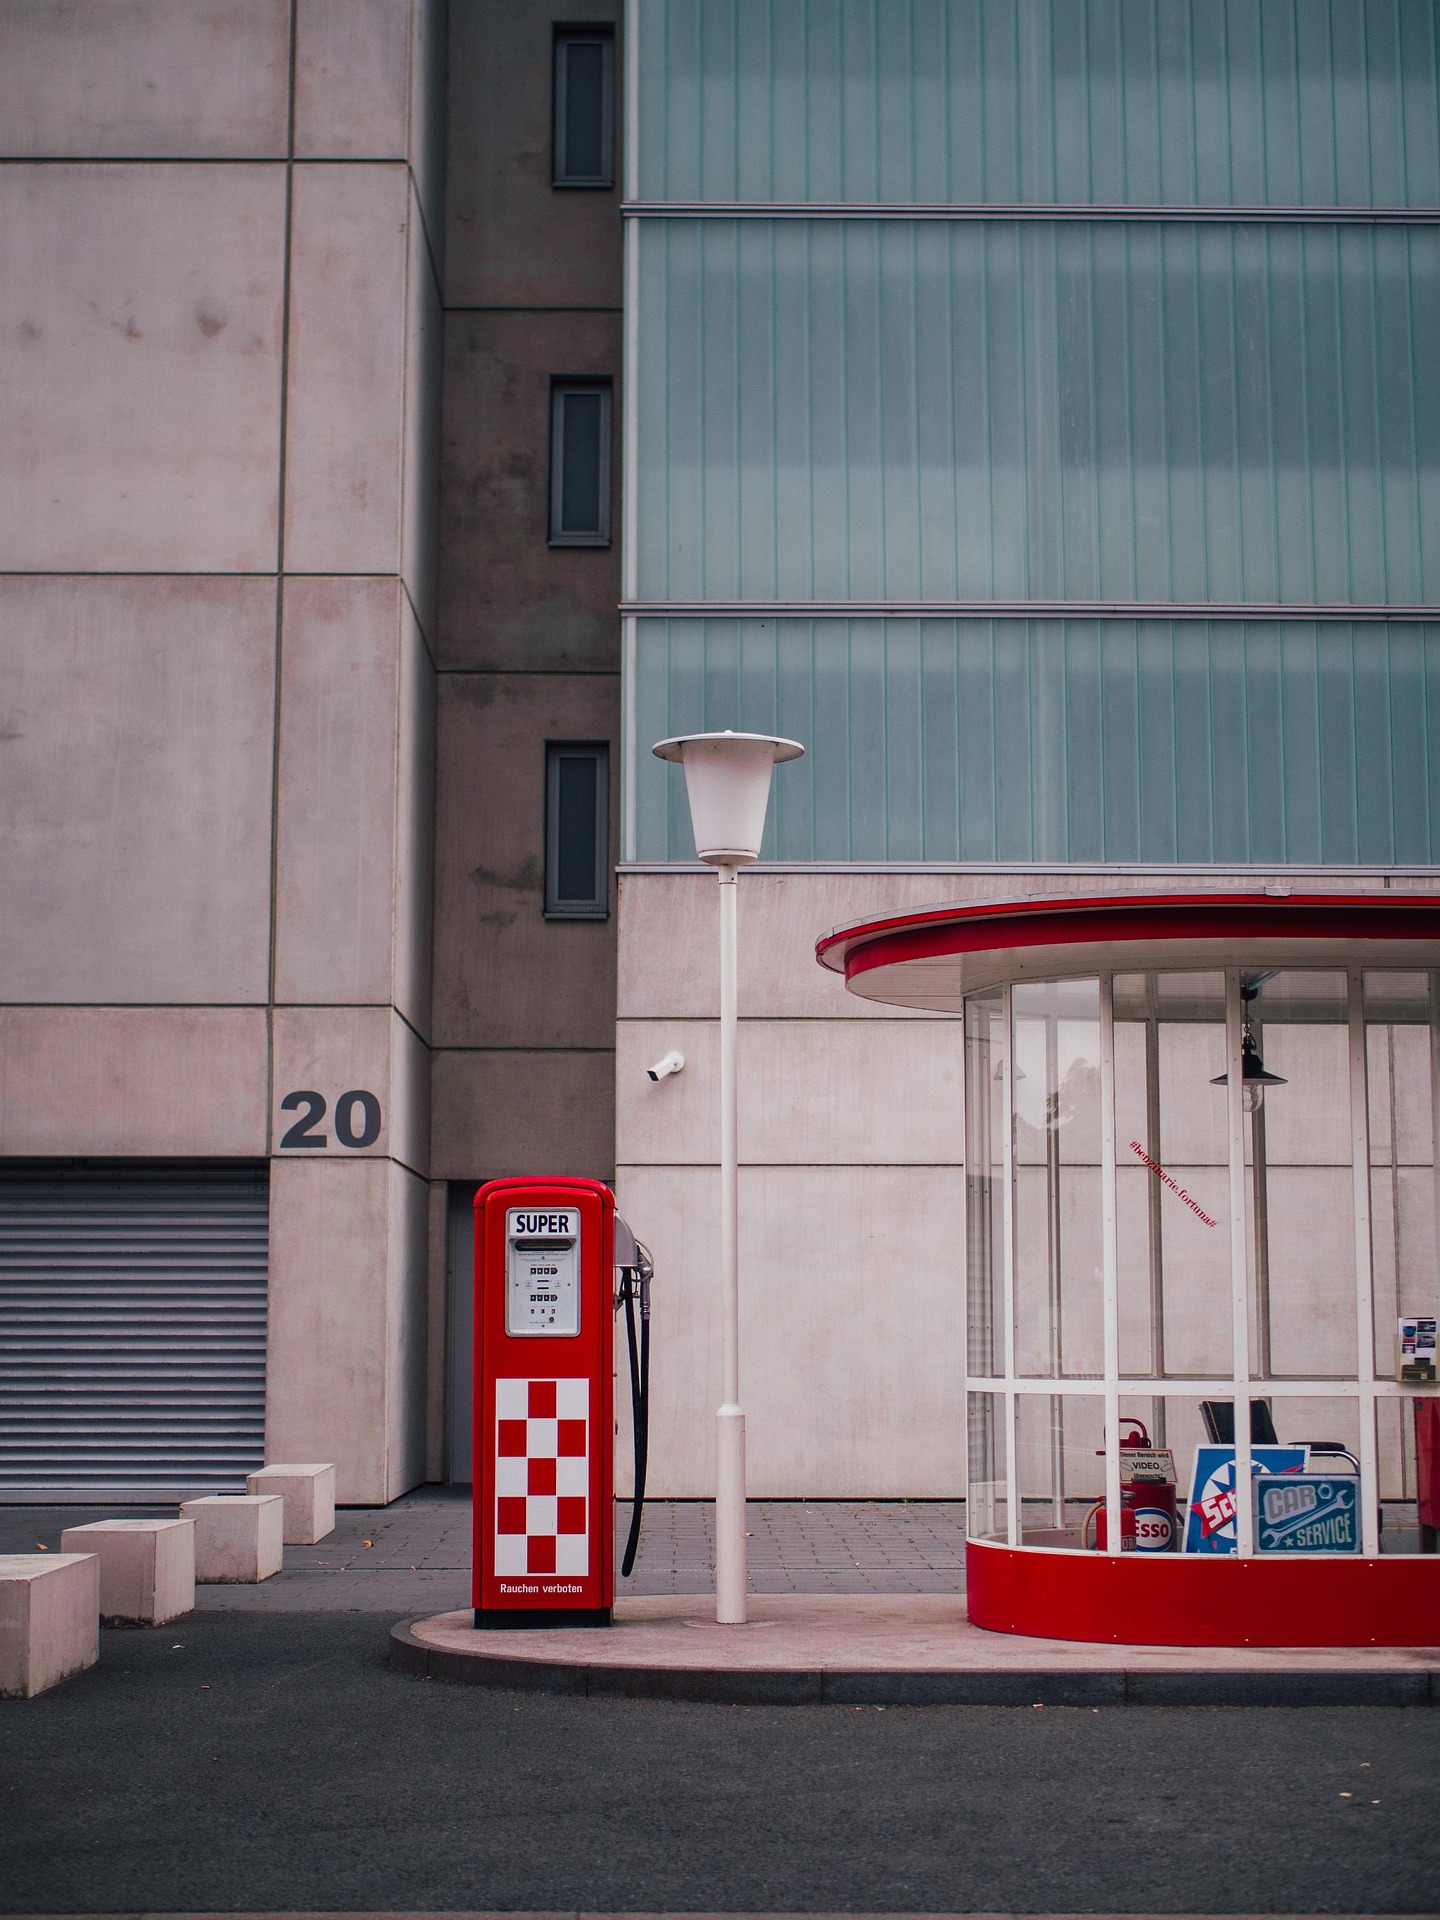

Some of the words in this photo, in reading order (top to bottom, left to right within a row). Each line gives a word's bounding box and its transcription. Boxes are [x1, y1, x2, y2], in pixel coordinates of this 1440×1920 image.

[280, 1090, 381, 1148] 20
[1129, 1140, 1218, 1228] #benzinarie.fortuna#
[516, 1214, 569, 1233] SUPER
[1266, 1485, 1316, 1518] CAR
[1296, 1512, 1352, 1547] SERVICE
[500, 1584, 539, 1593] Rauchen
[543, 1584, 582, 1593] verboten
